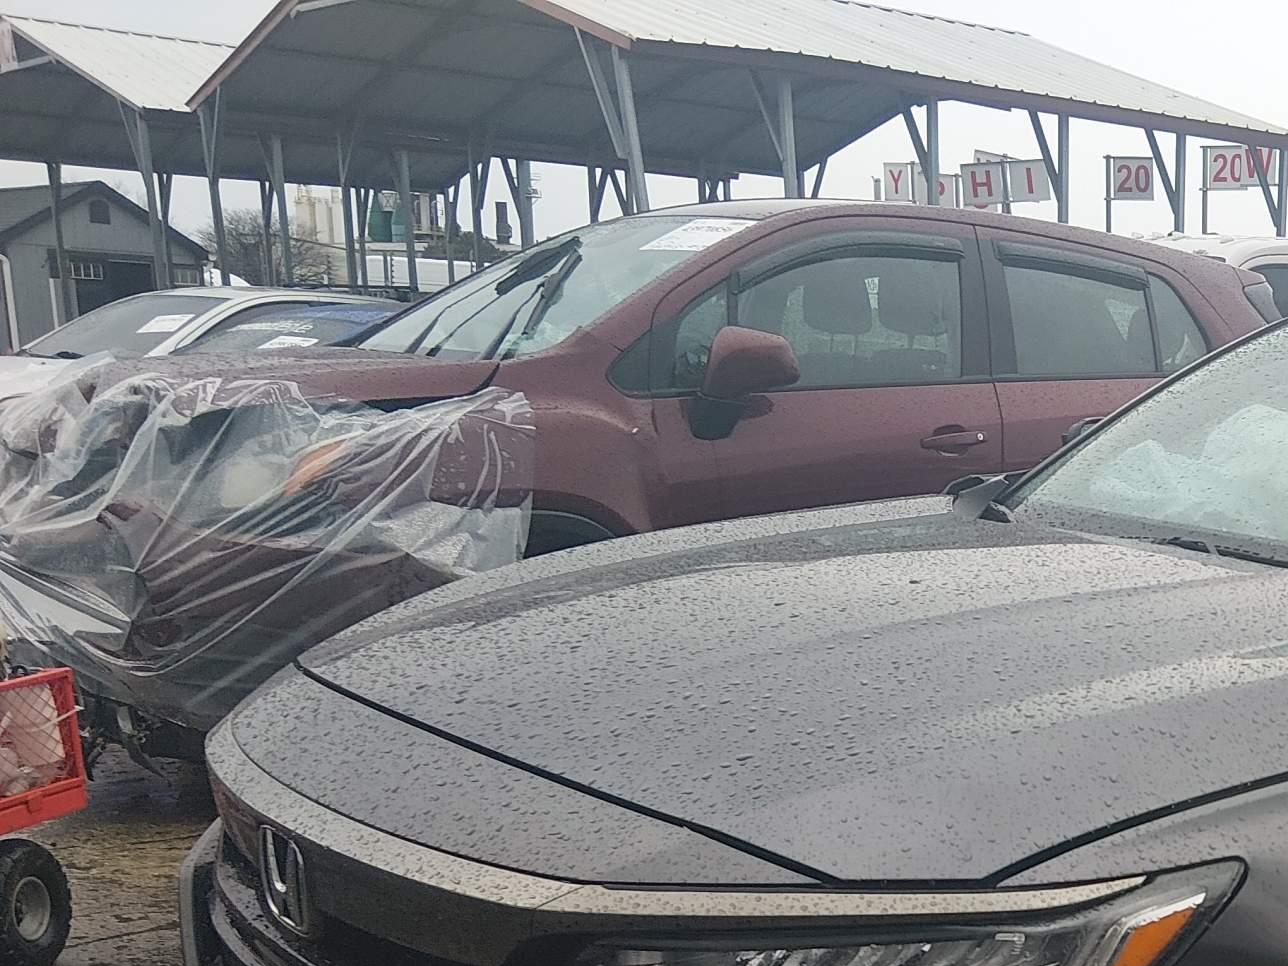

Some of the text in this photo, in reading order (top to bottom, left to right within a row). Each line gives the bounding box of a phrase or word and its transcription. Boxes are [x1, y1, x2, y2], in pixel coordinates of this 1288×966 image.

[890, 170, 902, 194] Y
[971, 170, 993, 198] H
[1026, 168, 1034, 194] I
[1118, 165, 1150, 193] 20
